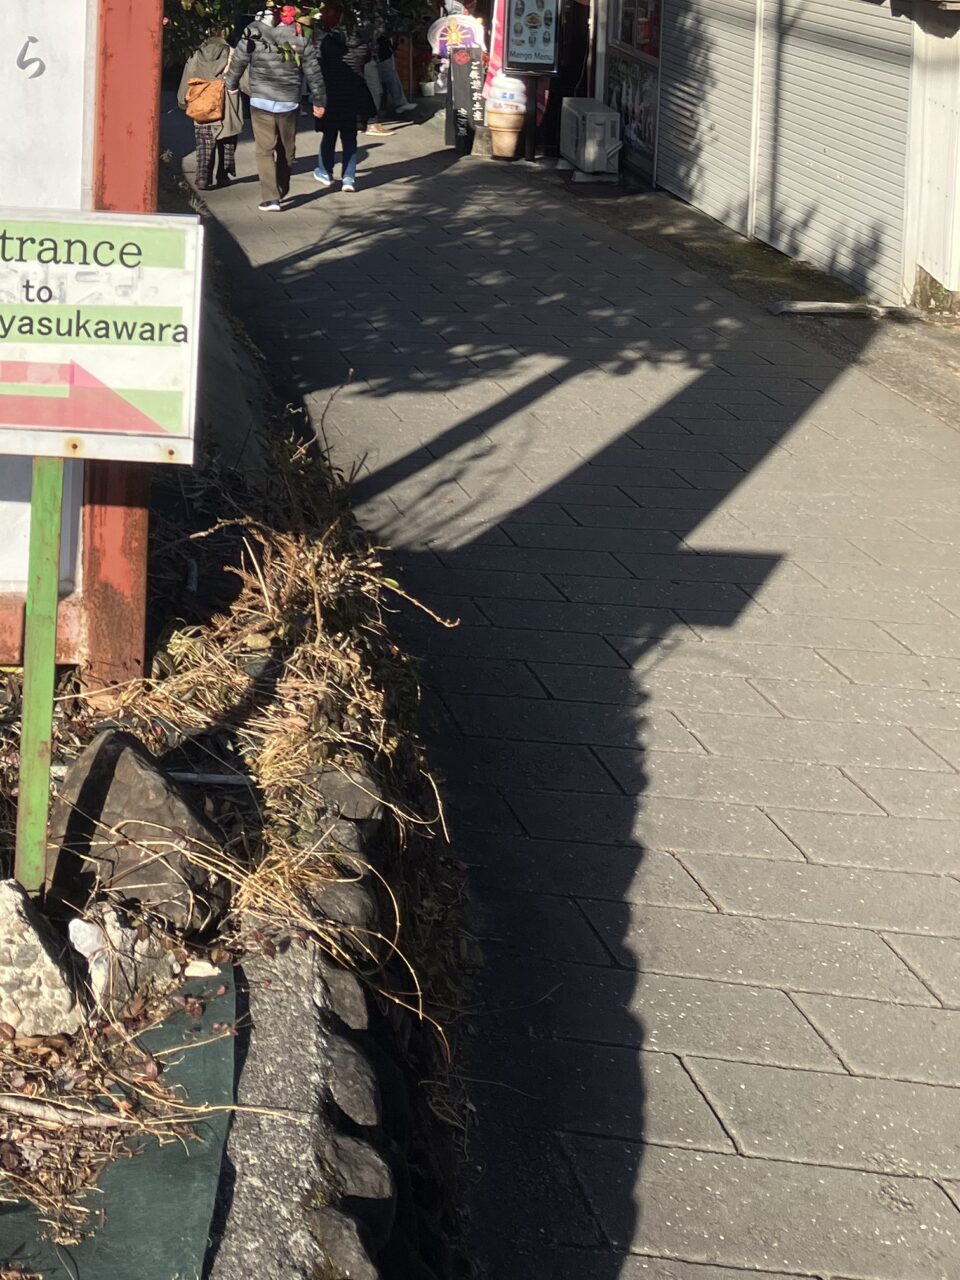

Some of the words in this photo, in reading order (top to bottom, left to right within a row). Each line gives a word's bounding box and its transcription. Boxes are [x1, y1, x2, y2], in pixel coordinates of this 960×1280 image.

[509, 50, 533, 61] Mango
[534, 51, 553, 61] Menu
[22, 278, 53, 303] to
